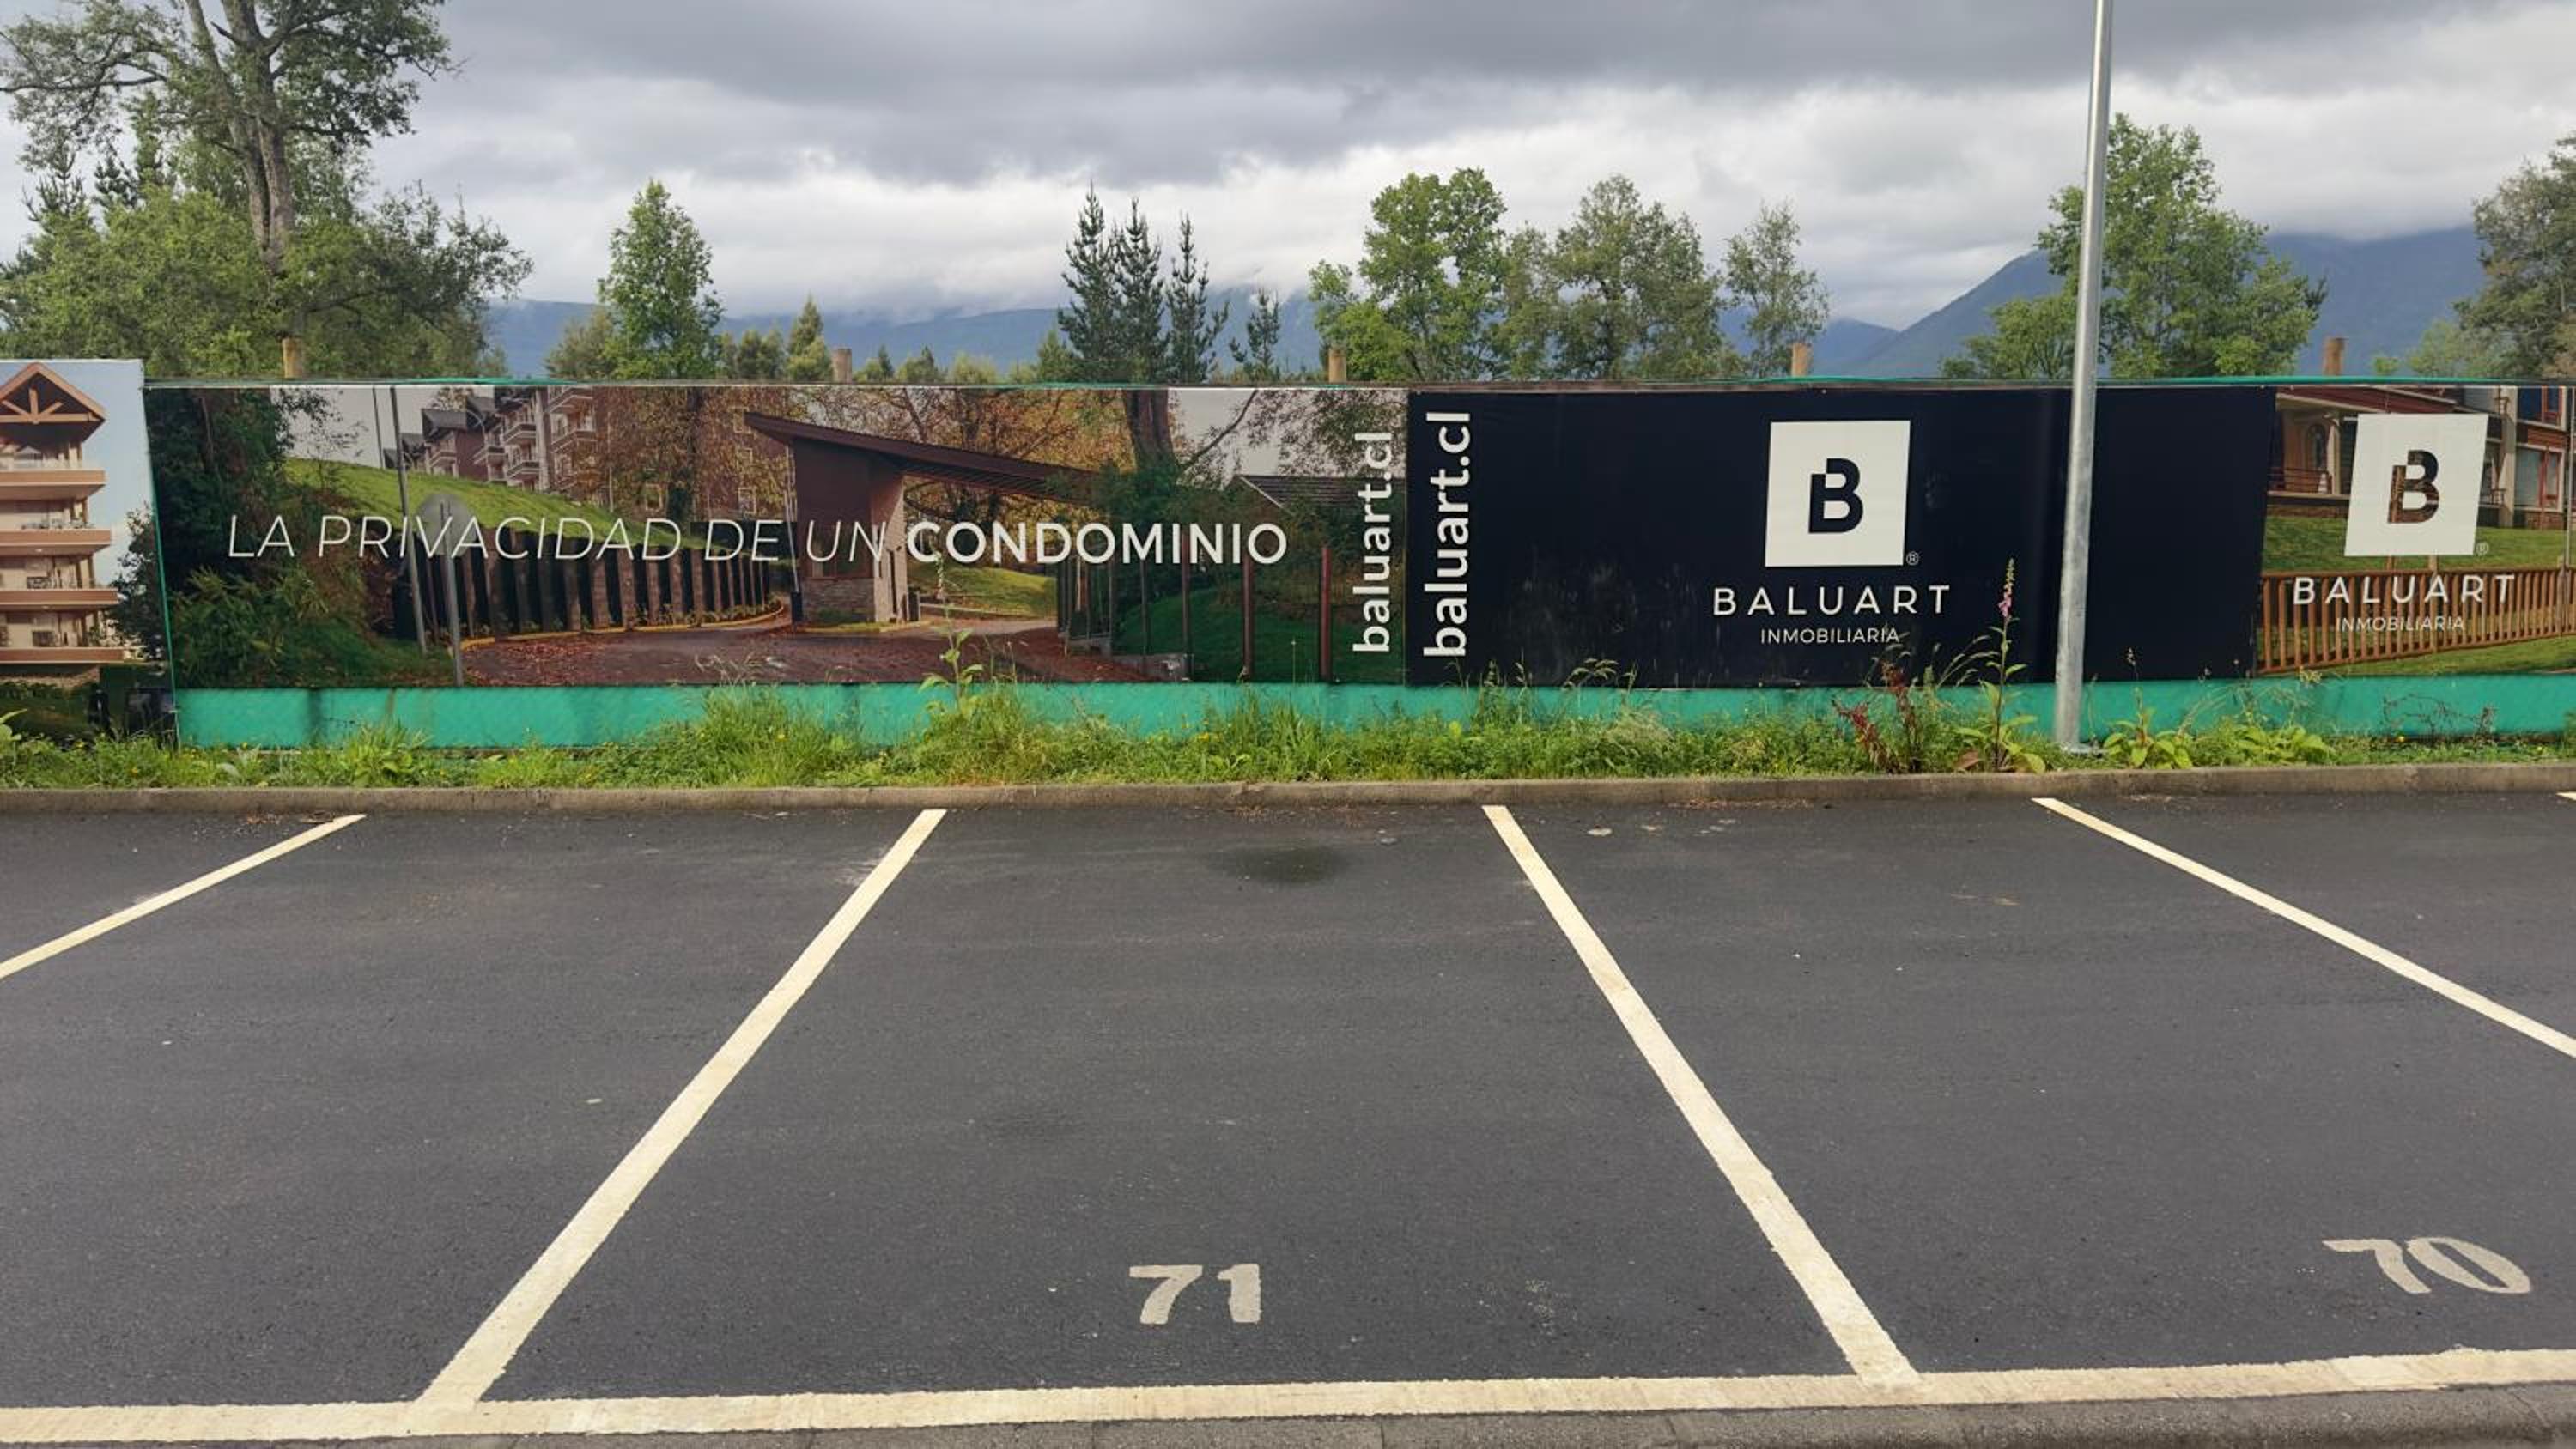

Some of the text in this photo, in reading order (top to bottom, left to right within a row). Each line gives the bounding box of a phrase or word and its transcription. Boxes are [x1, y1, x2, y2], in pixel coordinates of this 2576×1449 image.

[228, 515, 1288, 564] LA PRIVACIDAD DE UN CONDOMINIO
[1352, 432, 1393, 653] baluart.cl
[1423, 412, 1471, 657] baluart.cl
[1713, 585, 1950, 616] BALUART
[2293, 574, 2516, 605] BALUART
[1760, 627, 1900, 644] INMOBILIARIA
[2336, 615, 2465, 632] INMOBILIARIA
[2322, 1237, 2531, 1294] 70
[1129, 1263, 1261, 1325] 71
